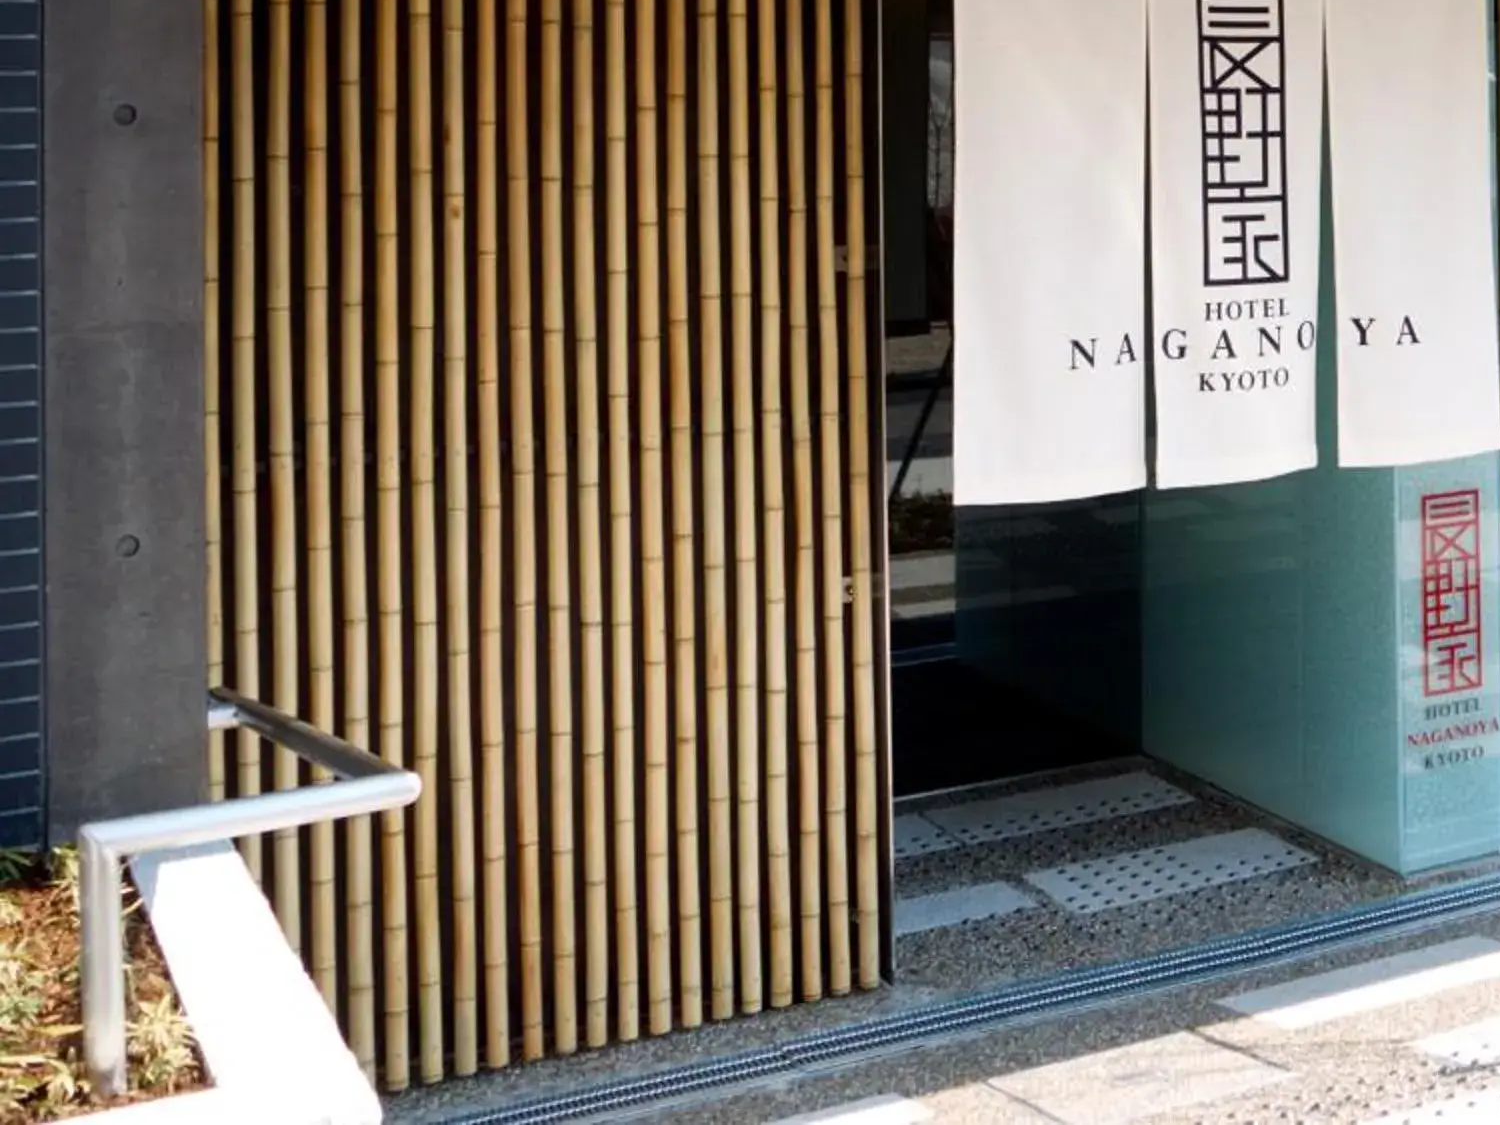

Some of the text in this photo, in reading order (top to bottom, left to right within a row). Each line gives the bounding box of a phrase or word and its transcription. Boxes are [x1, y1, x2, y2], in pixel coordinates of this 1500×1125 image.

[1204, 299, 1290, 321] HOTEL
[1198, 367, 1290, 393] KYOTO
[1424, 698, 1481, 720] HOTEL
[1407, 718, 1500, 746] NAGANOYA
[1424, 746, 1485, 769] KYOTO
